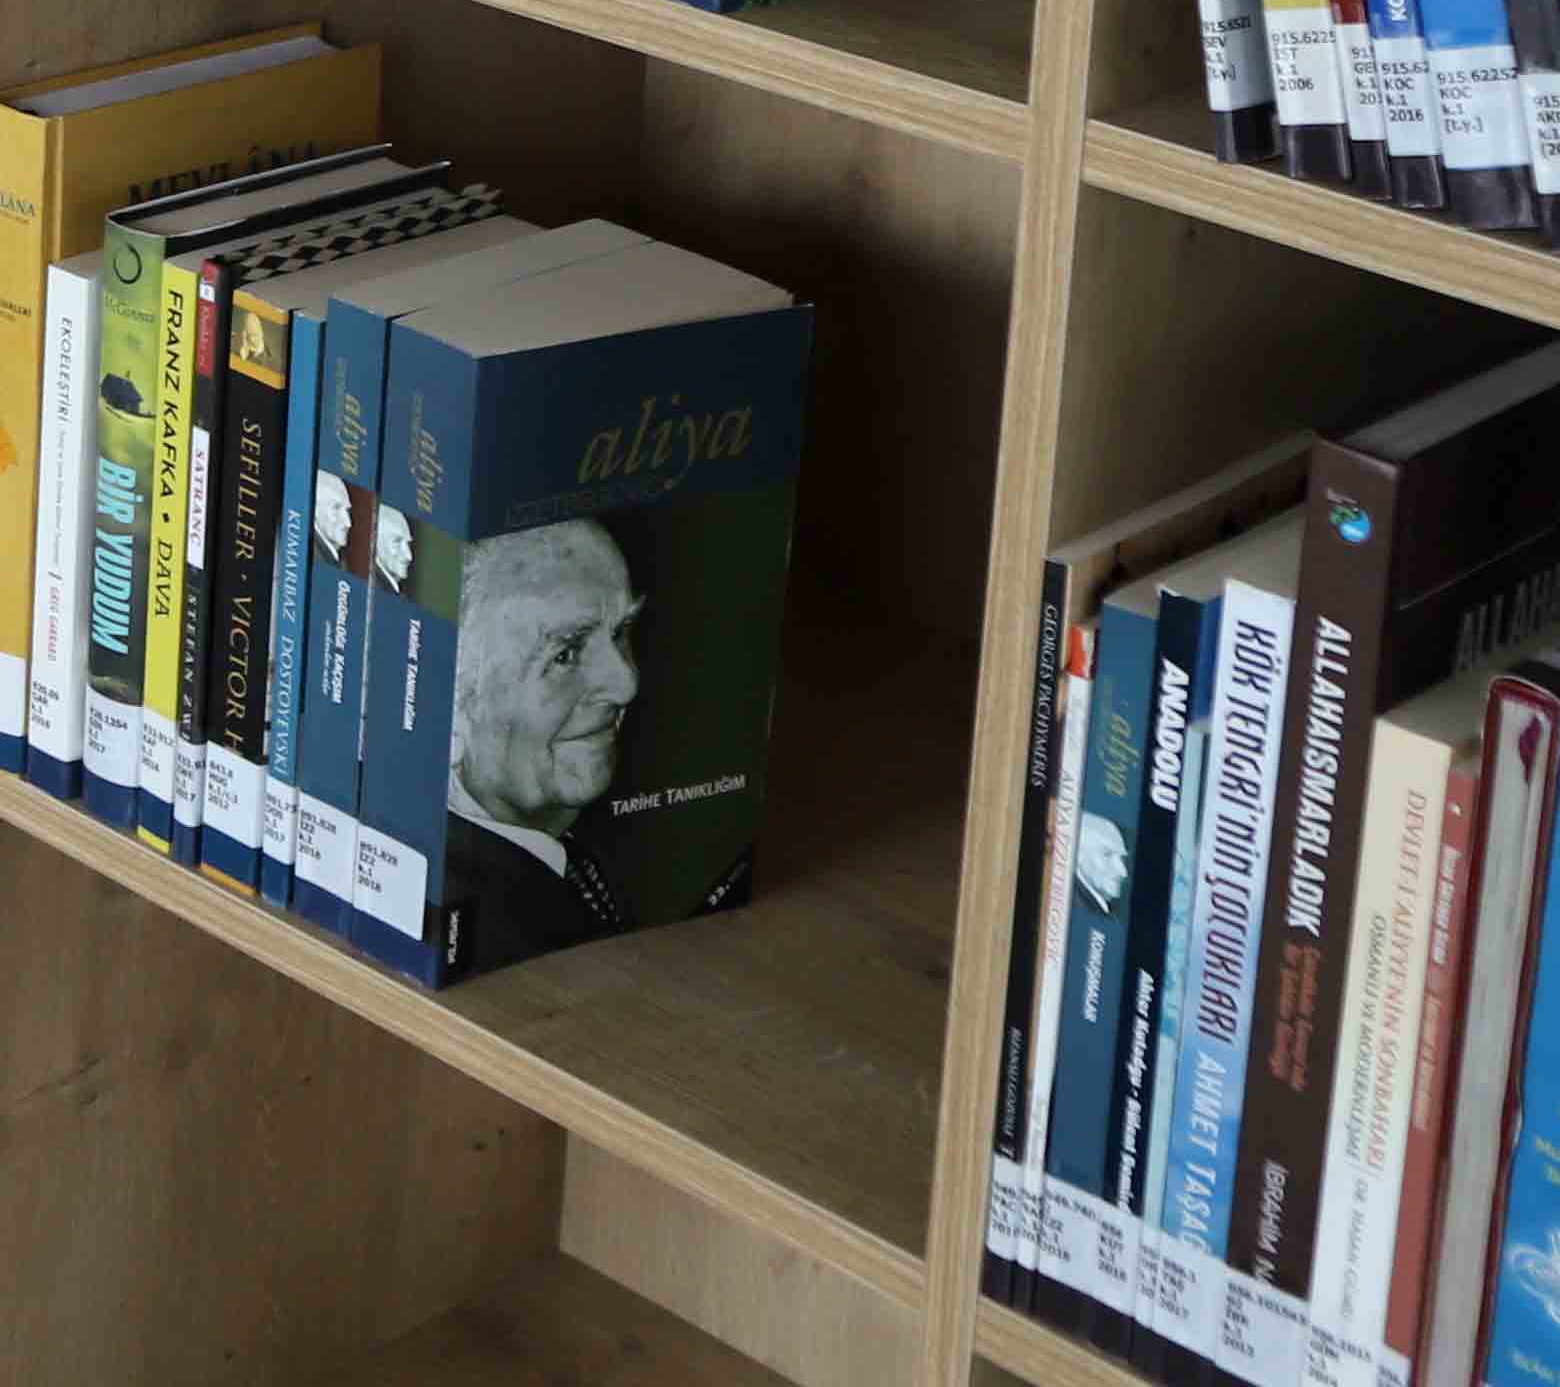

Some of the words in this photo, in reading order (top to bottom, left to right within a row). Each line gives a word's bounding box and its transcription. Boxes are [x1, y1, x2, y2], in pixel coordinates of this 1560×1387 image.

[164, 289, 186, 391] FRANZ
[97, 456, 138, 523] BİR
[159, 400, 180, 499] KAFKA
[234, 417, 263, 561] SEFİLLER
[578, 396, 753, 485] aliya
[92, 525, 136, 656] YUDUM
[153, 537, 173, 618] DAVA
[281, 508, 304, 623] KUMARBAZ
[218, 592, 252, 718] VICTOR
[1233, 619, 1276, 689] KÖK
[1151, 657, 1191, 814] ANADOLU
[1284, 615, 1353, 939] ALLAHAISMARLADIK
[611, 790, 662, 817] TARİHE
[667, 773, 746, 806] TANIKLIĞIM
